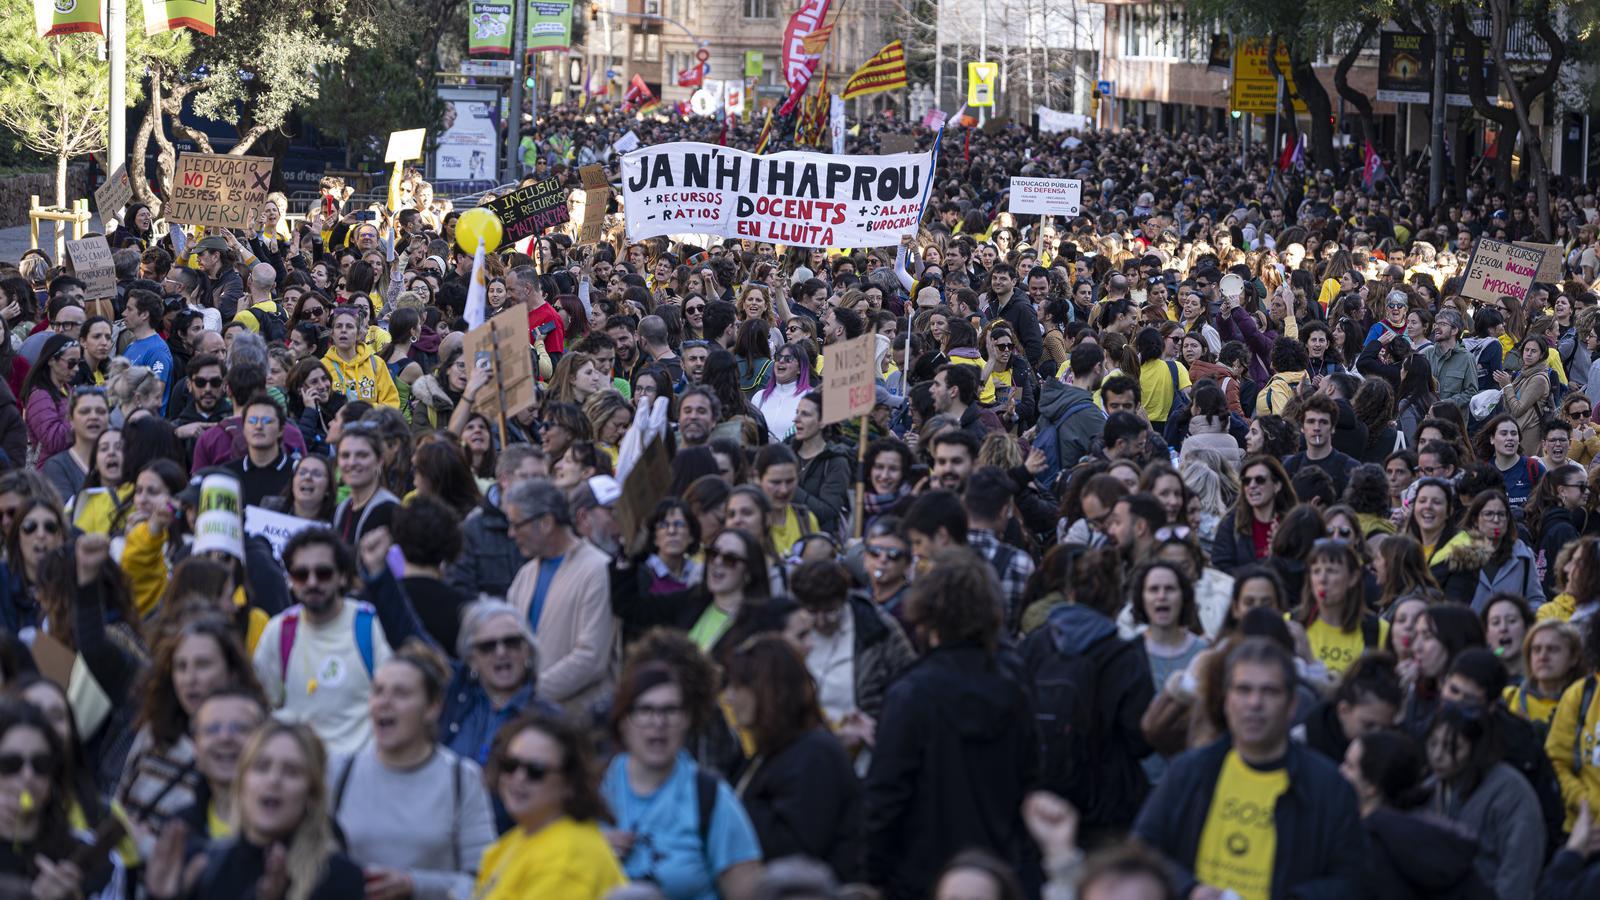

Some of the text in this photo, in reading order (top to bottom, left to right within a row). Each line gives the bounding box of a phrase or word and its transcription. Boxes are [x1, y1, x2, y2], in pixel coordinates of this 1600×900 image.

[184, 172, 204, 188] NO
[225, 177, 247, 189] UNA
[628, 153, 674, 193] JA
[767, 159, 820, 199] HA
[826, 162, 920, 202] PROU
[175, 187, 222, 202] DESPESA
[243, 191, 265, 204] UNA
[520, 191, 566, 216] RECURSOS
[656, 192, 723, 206] RECURSOS
[736, 195, 847, 225] DOCENTS
[506, 205, 569, 241] MALTRACTAR
[737, 220, 761, 238] EN
[69, 240, 101, 254] NO VULL
[1479, 240, 1502, 253] SENSE
[1506, 246, 1541, 264] RECURSOS
[1474, 254, 1503, 270] L'ESCOLA
[1320, 645, 1353, 663] SOS
[1219, 797, 1273, 830] SOS
